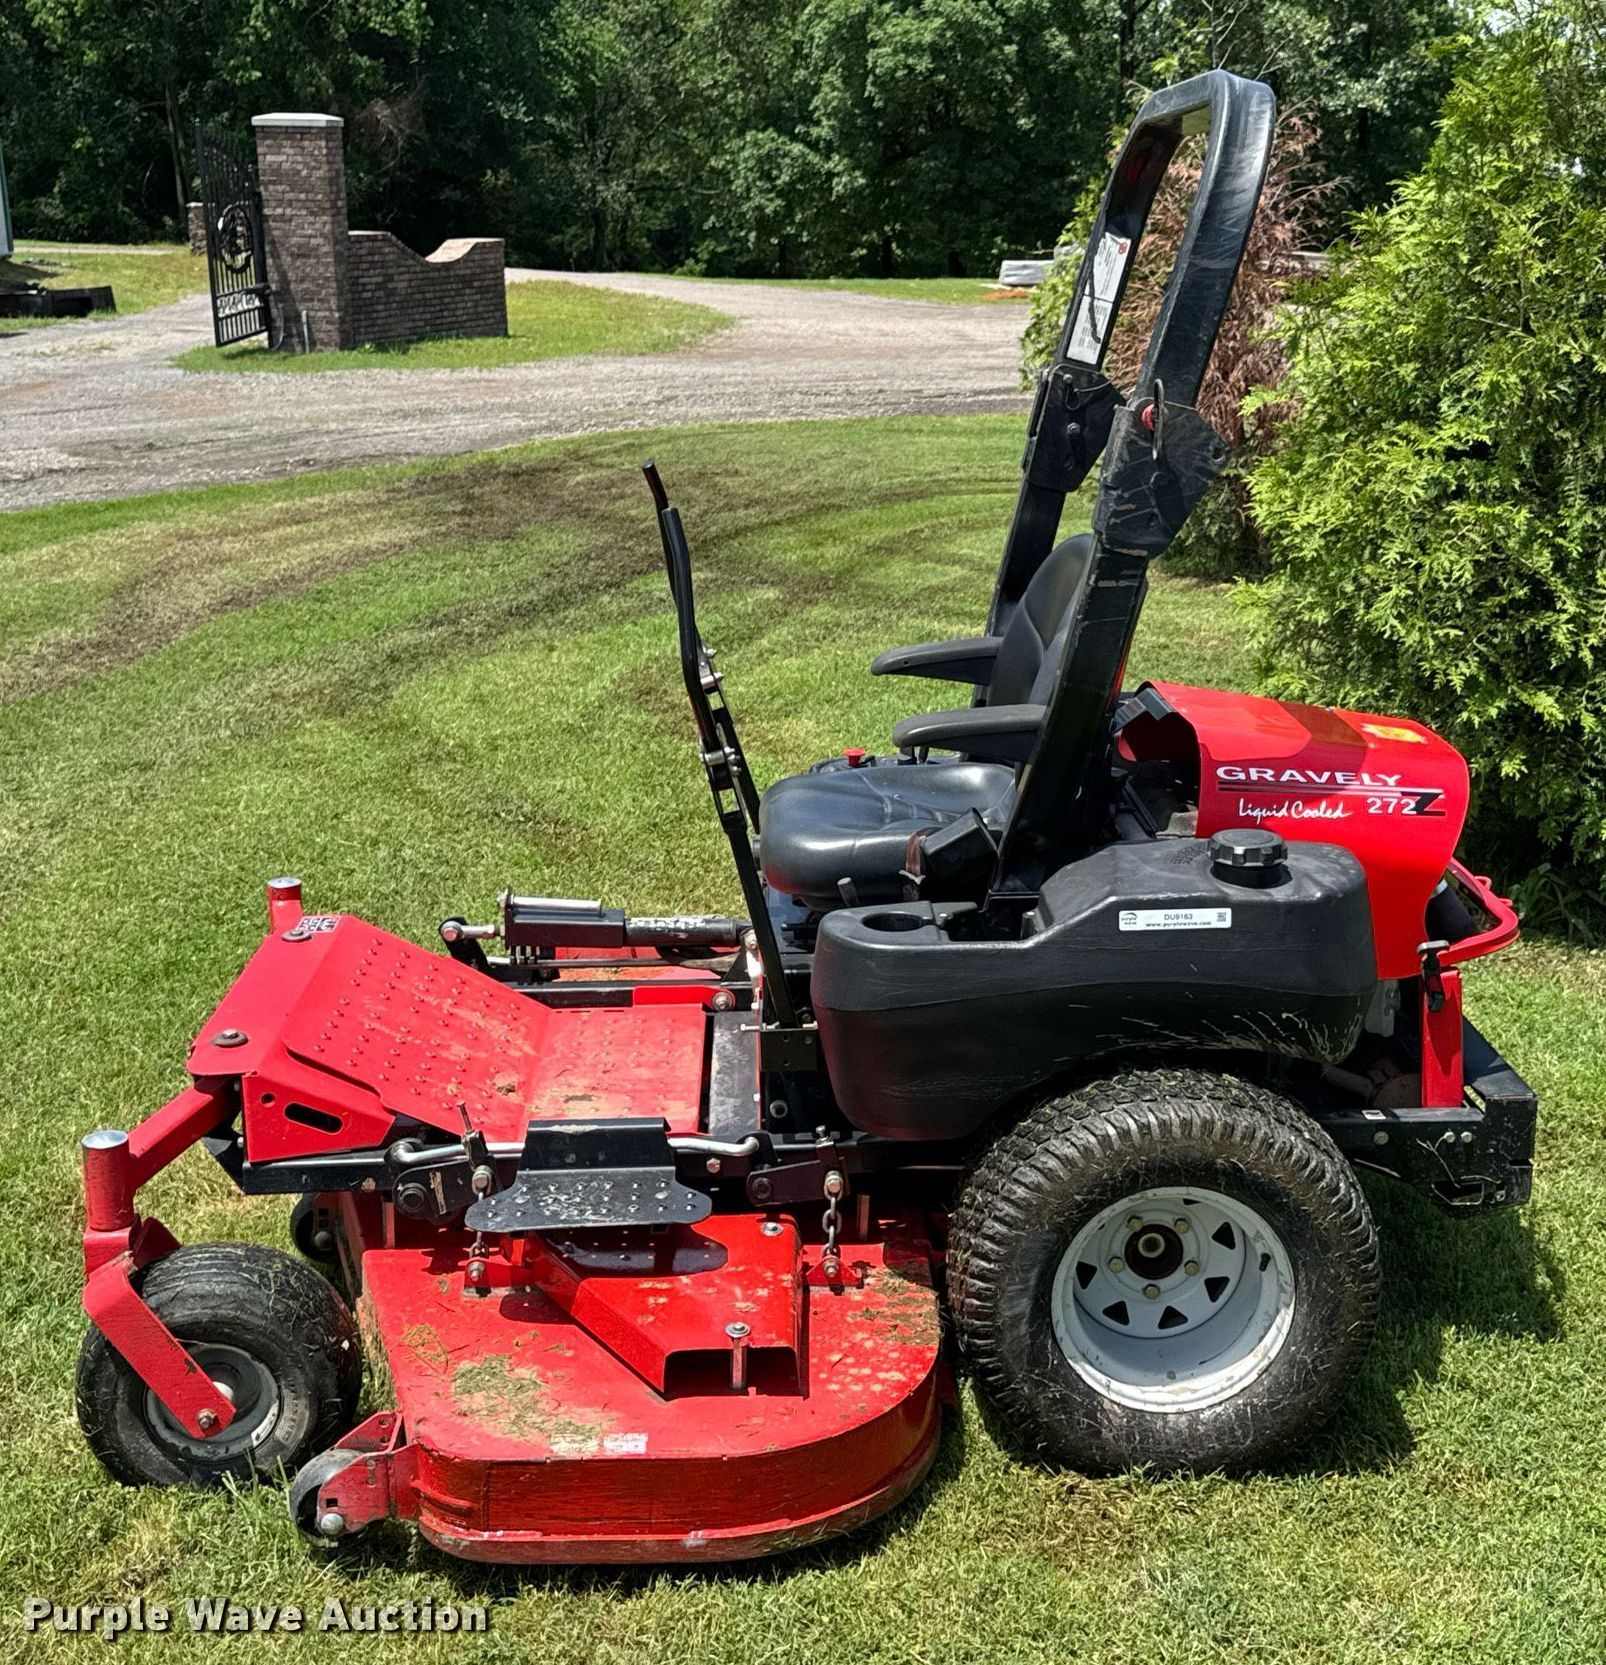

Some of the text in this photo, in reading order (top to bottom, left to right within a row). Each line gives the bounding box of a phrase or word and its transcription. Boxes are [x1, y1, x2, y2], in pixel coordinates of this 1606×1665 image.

[1216, 766, 1402, 786] GRAVELY
[1239, 798, 1352, 825] Liquid Cooled
[1164, 913, 1193, 921] DU9163
